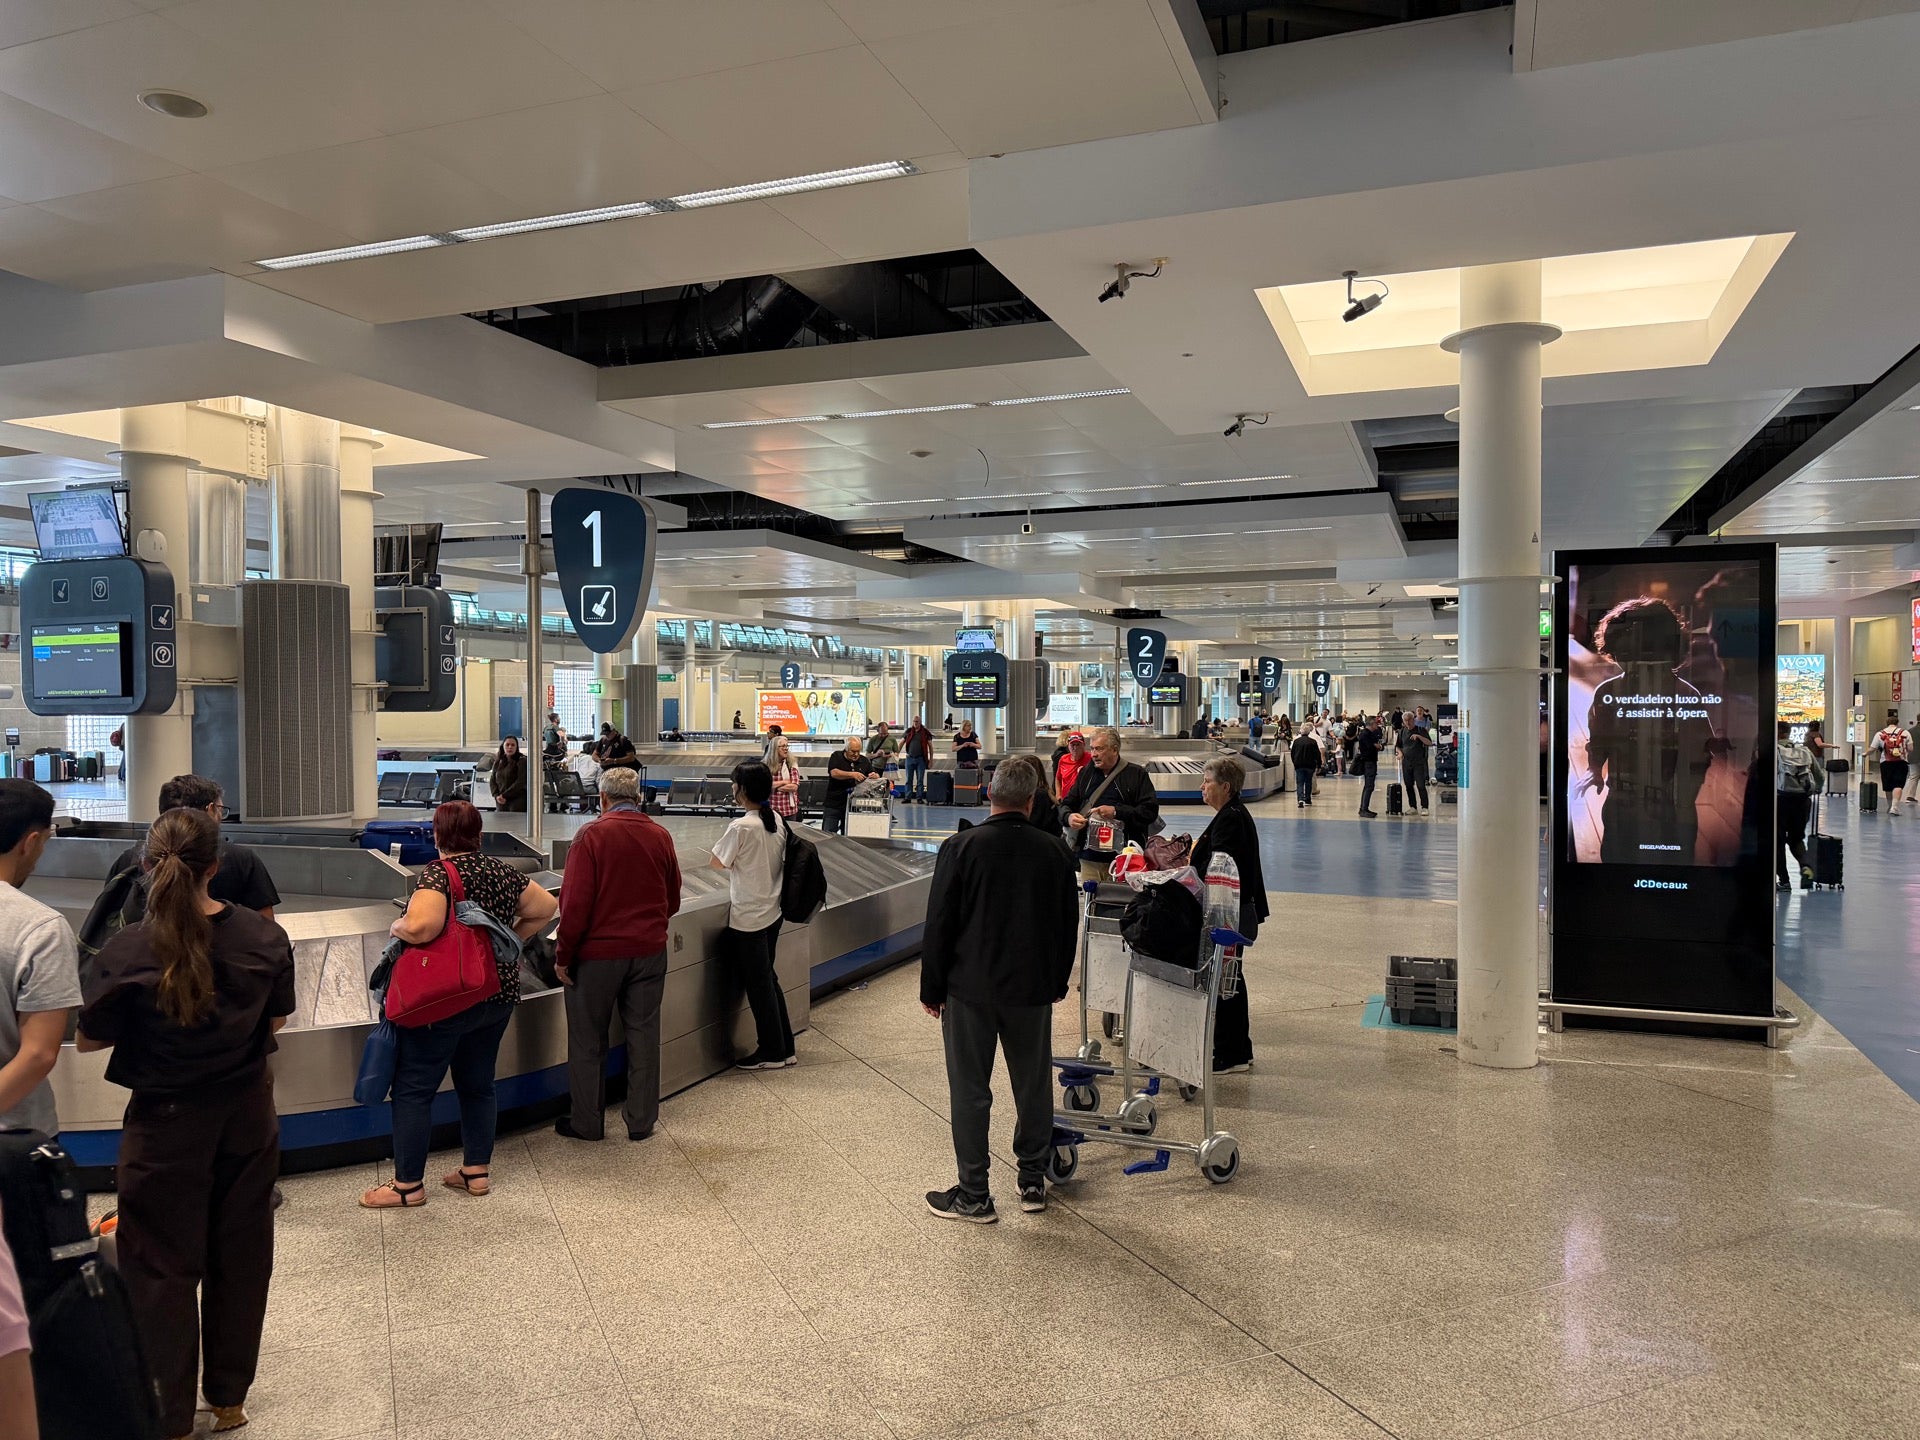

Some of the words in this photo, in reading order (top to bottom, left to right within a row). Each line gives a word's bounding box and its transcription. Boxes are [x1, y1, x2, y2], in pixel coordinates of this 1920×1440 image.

[581, 510, 602, 568] 1
[1138, 635, 1153, 658] 2
[1265, 661, 1275, 675] 3
[1779, 656, 1823, 668] WOW
[786, 667, 794, 680] 3
[1316, 673, 1325, 684] 4
[1602, 694, 1613, 704] O
[1615, 694, 1672, 704] verdadeiro
[1675, 694, 1699, 704] luxo
[1701, 694, 1722, 704] não
[1616, 707, 1623, 718] é
[1625, 708, 1664, 718] assistir
[1666, 708, 1674, 718] à
[1676, 707, 1708, 720] ópera
[1633, 879, 1688, 890] JCDecaux
